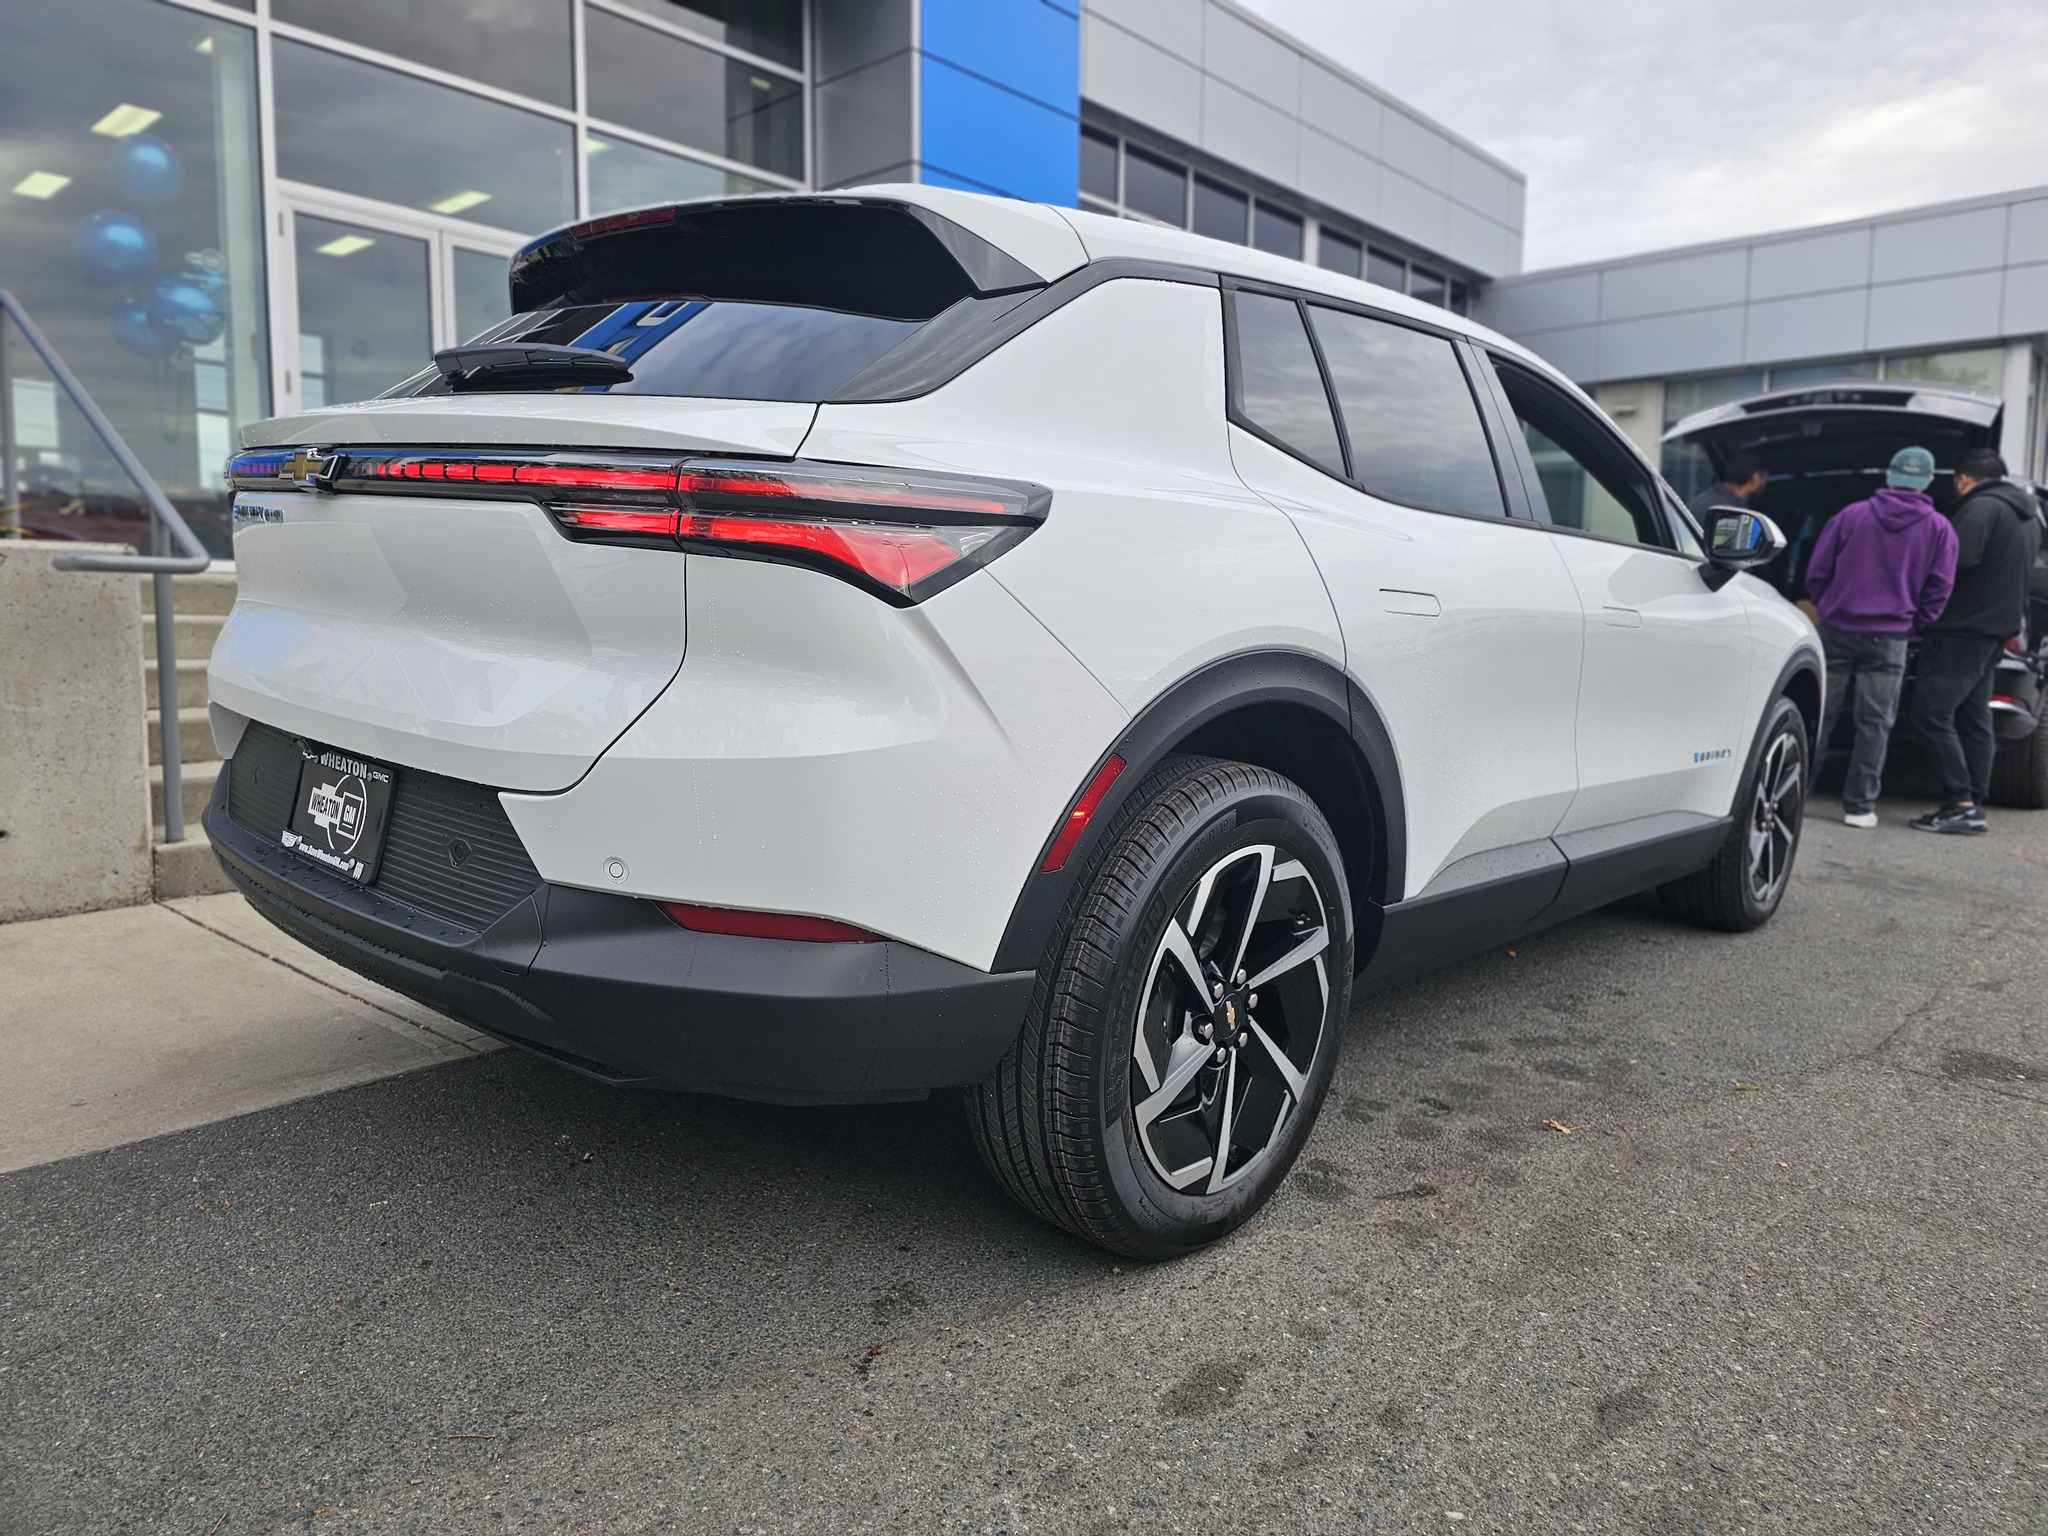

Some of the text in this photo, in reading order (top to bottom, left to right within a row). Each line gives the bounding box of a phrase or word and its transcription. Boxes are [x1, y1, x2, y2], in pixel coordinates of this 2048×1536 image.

[321, 752, 390, 783] WHEATON GMC
[311, 792, 341, 820] WHEATON
[344, 804, 357, 825] GM
